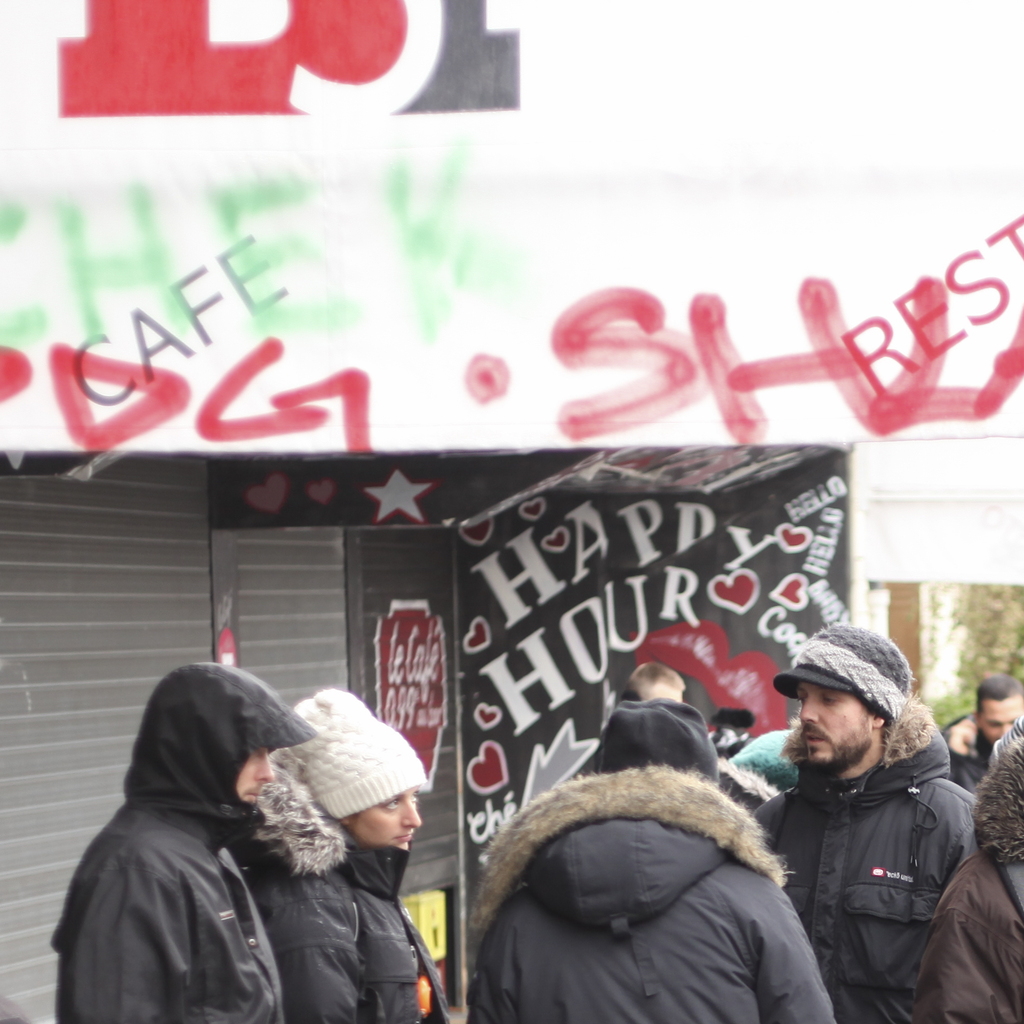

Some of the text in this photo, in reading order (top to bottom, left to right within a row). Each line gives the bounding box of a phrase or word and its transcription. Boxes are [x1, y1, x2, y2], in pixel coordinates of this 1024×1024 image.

[70, 234, 289, 406] CAFE
[470, 499, 777, 630] HAPPY
[479, 565, 701, 737] HOUR
